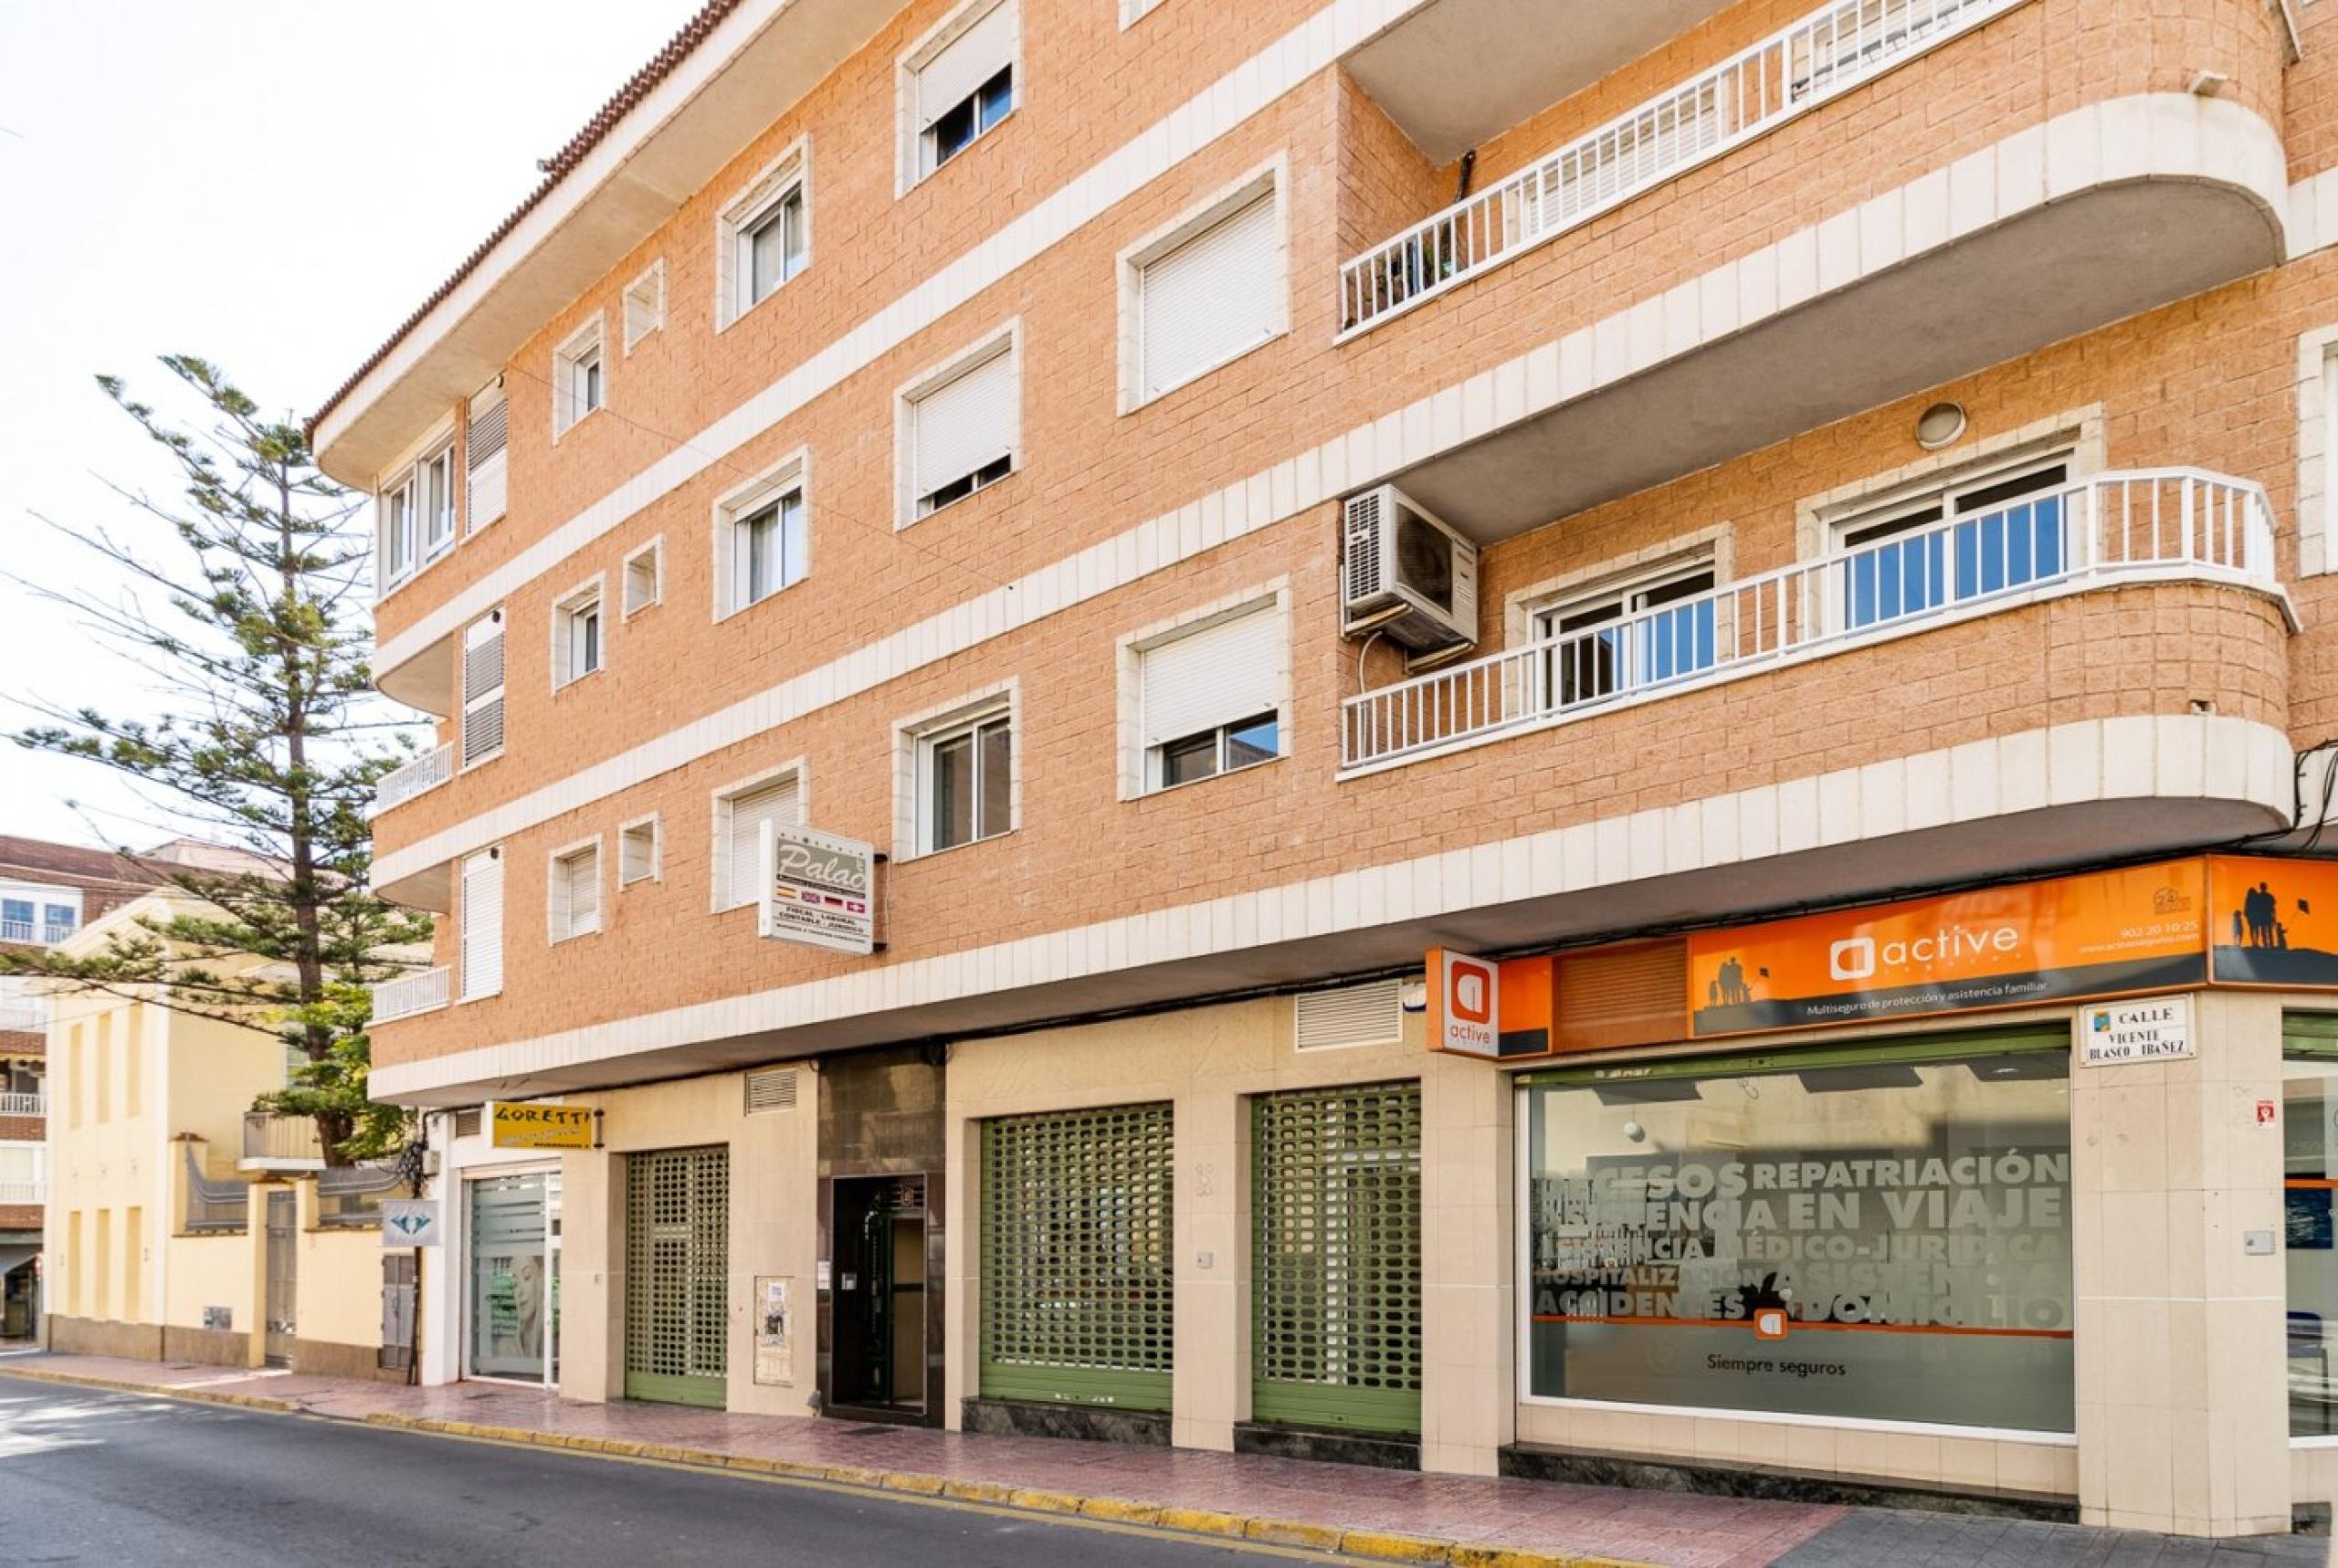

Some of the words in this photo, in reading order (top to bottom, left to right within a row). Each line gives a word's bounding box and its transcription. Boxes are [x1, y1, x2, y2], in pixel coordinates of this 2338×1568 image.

[1881, 924, 2019, 966] active
[1806, 1001, 1865, 1016] Multiseguro
[1868, 998, 1880, 1009] de
[1881, 993, 1938, 1010] protección
[1947, 986, 2003, 1002] asistencia
[2004, 981, 2047, 994] familiar
[2119, 1007, 2174, 1025] CALLE
[1449, 1024, 1490, 1045] active
[2109, 1029, 2159, 1045] VICENTE
[2089, 1046, 2131, 1059] BLASCO
[1753, 1148, 2069, 1190] REPATRIACIÓN
[1788, 1192, 1860, 1230] EN
[1881, 1186, 2062, 1230] VIAJE
[1706, 1354, 1774, 1374] Siempre
[1778, 1361, 1846, 1378] seguros
